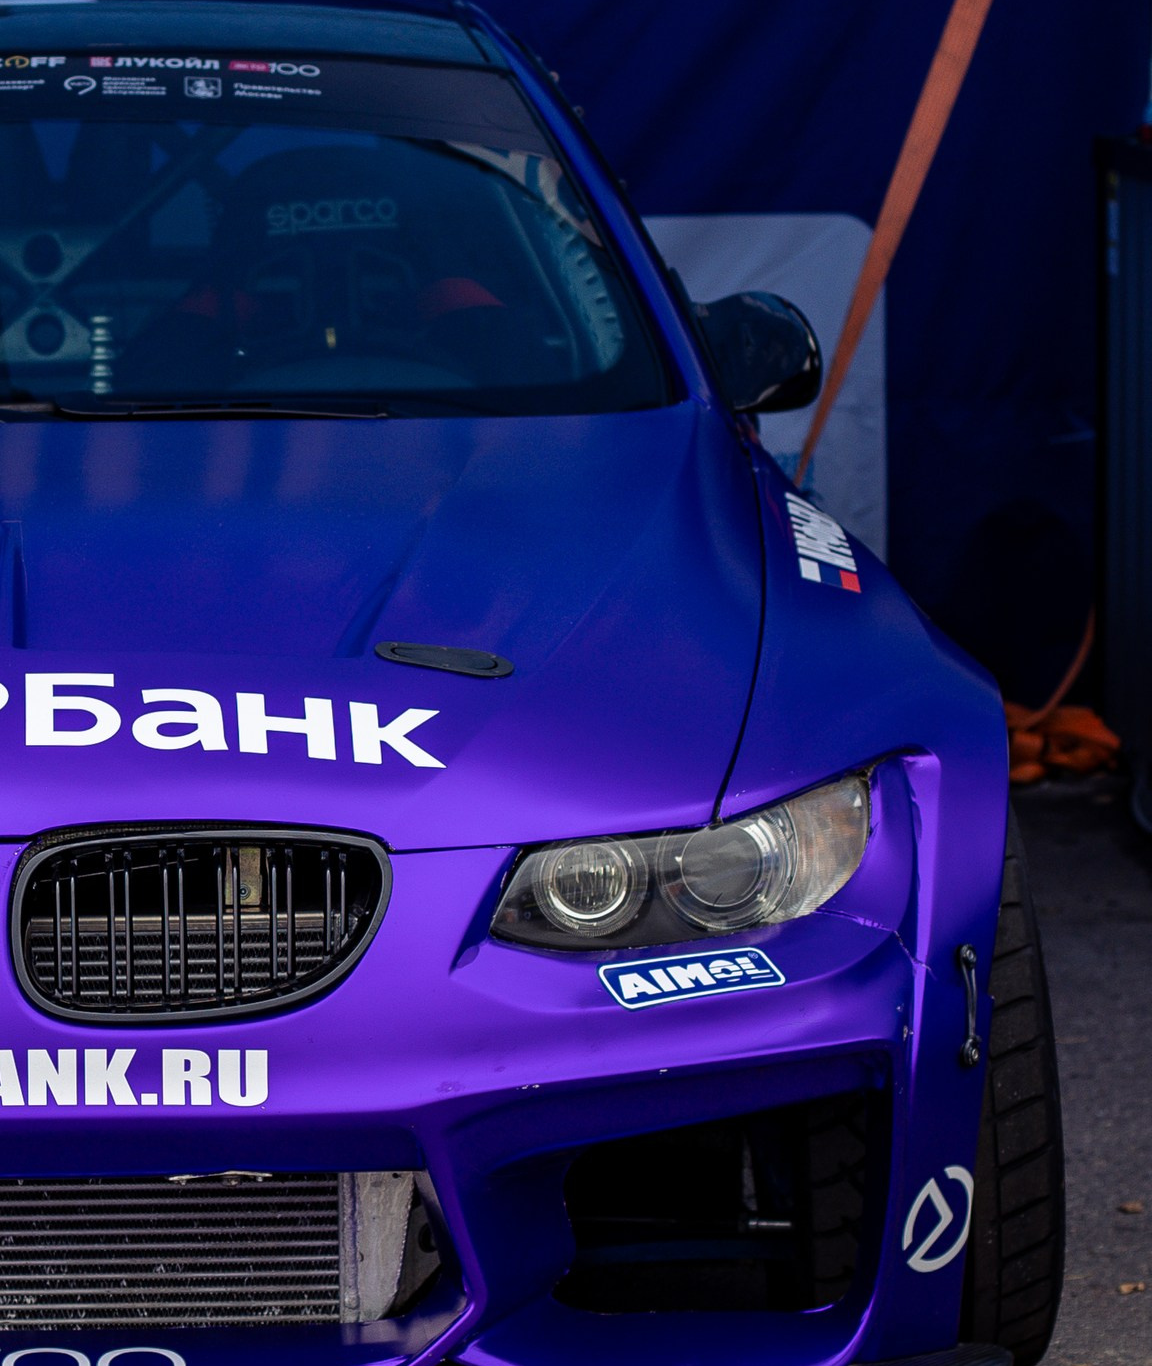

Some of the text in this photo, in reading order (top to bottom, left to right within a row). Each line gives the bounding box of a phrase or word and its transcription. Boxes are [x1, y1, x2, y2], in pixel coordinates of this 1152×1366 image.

[114, 56, 220, 70] ЛУКОЙЛ
[266, 197, 399, 235] sparco
[618, 956, 774, 1000] AIMOL
